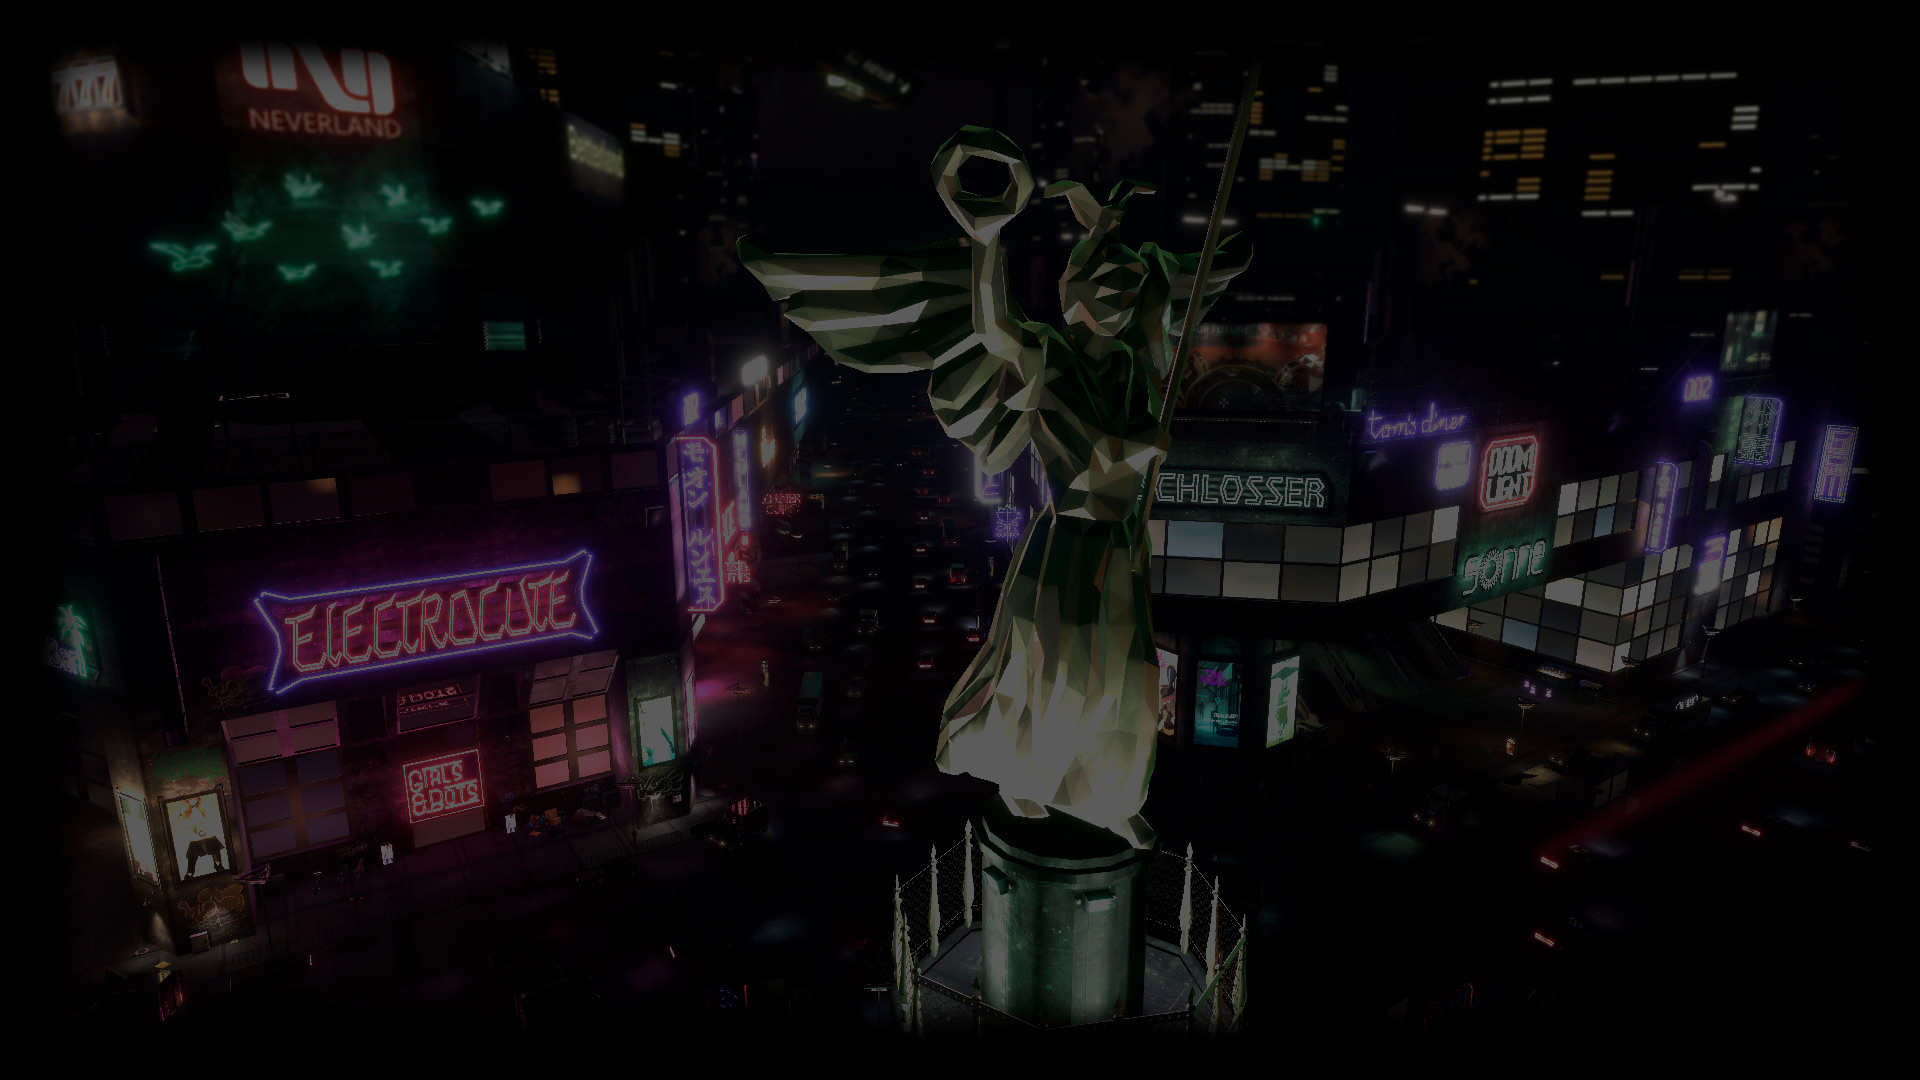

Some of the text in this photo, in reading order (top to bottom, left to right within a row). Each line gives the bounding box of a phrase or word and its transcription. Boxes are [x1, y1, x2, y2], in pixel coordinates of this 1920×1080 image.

[249, 108, 402, 139] NEVERLAND
[1368, 402, 1467, 439] tom's diner
[285, 569, 577, 672] ELECTROCUTE
[408, 759, 463, 793] GIRLS
